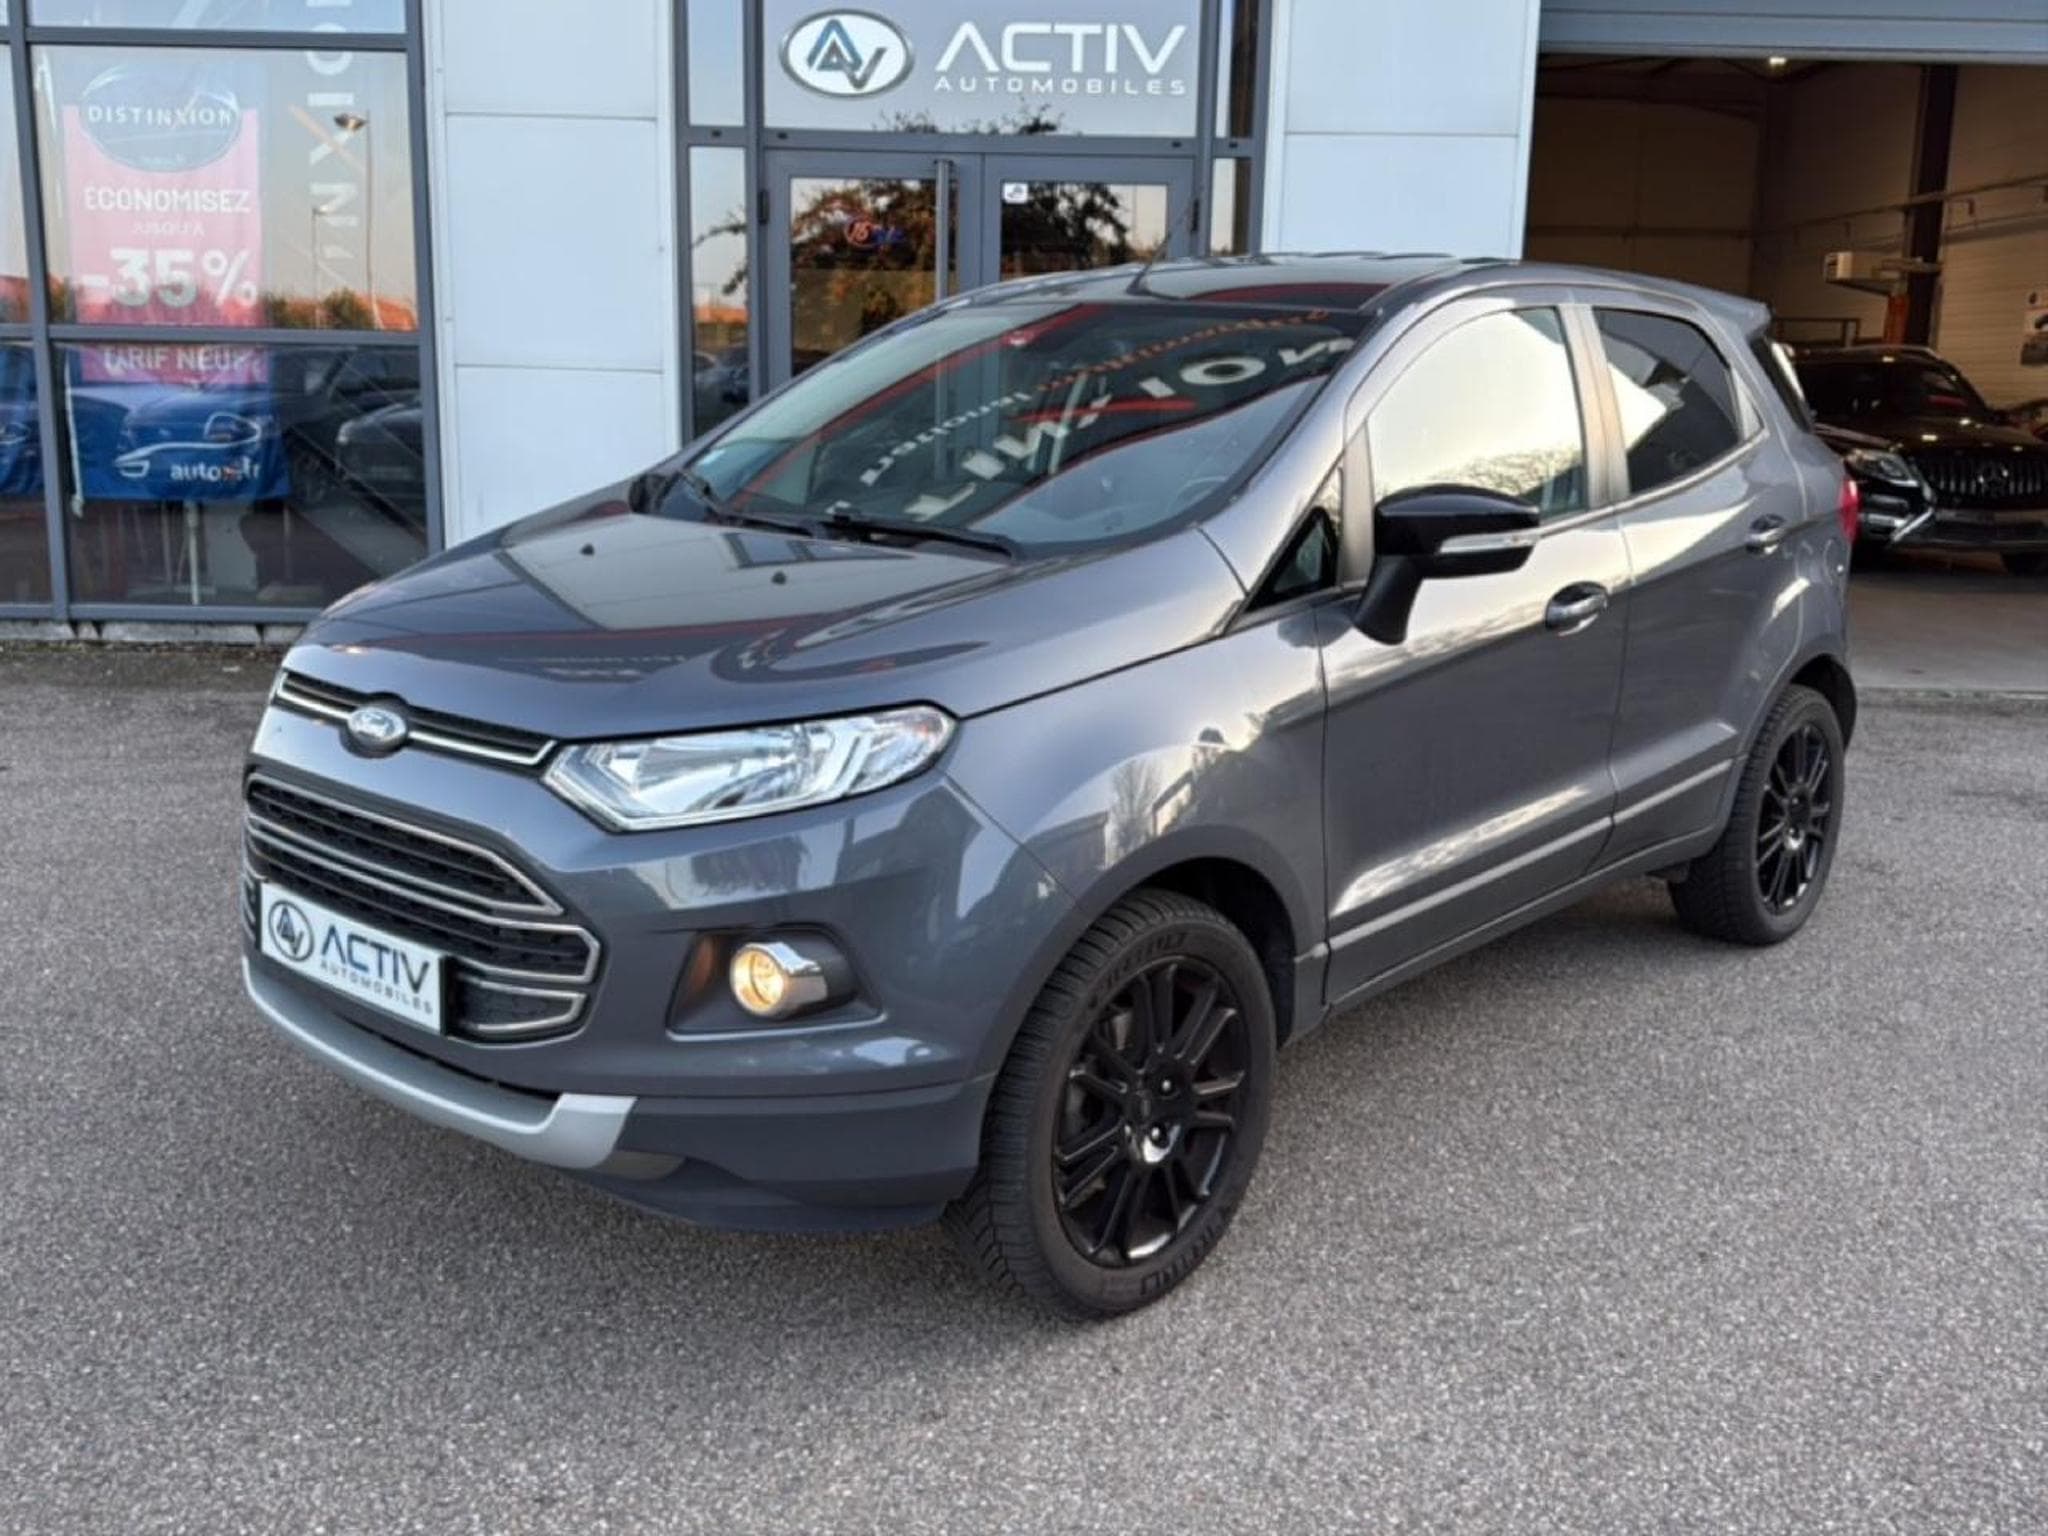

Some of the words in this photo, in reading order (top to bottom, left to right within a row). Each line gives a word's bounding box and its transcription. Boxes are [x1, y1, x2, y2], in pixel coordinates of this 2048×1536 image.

[934, 21, 1187, 75] ACTIV
[934, 76, 1187, 95] AUTOMOBILES
[87, 105, 232, 126] DISTINXION
[322, 924, 430, 993] ACTIV
[320, 959, 434, 1015] AUTOMOBILES
